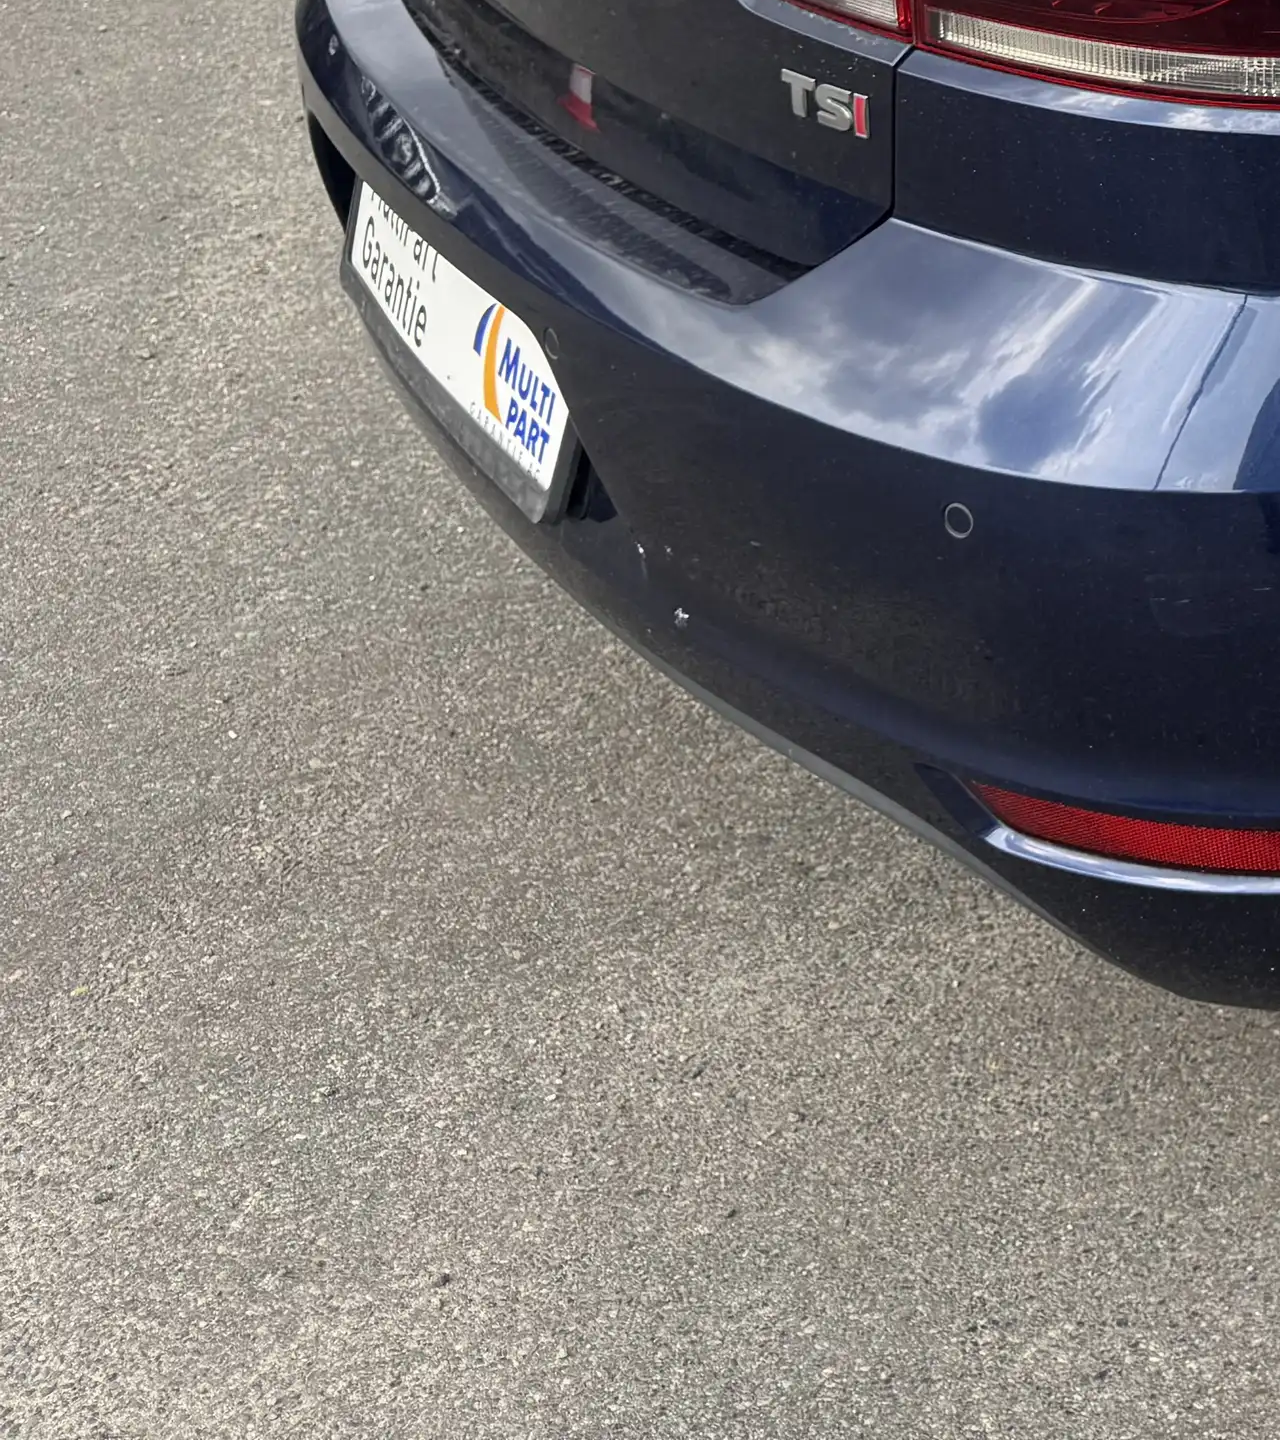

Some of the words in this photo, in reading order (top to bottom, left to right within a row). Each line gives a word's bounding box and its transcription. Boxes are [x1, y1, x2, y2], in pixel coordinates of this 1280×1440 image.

[362, 216, 427, 348] Garantie
[498, 337, 556, 427] MULTI
[505, 396, 550, 465] PART
